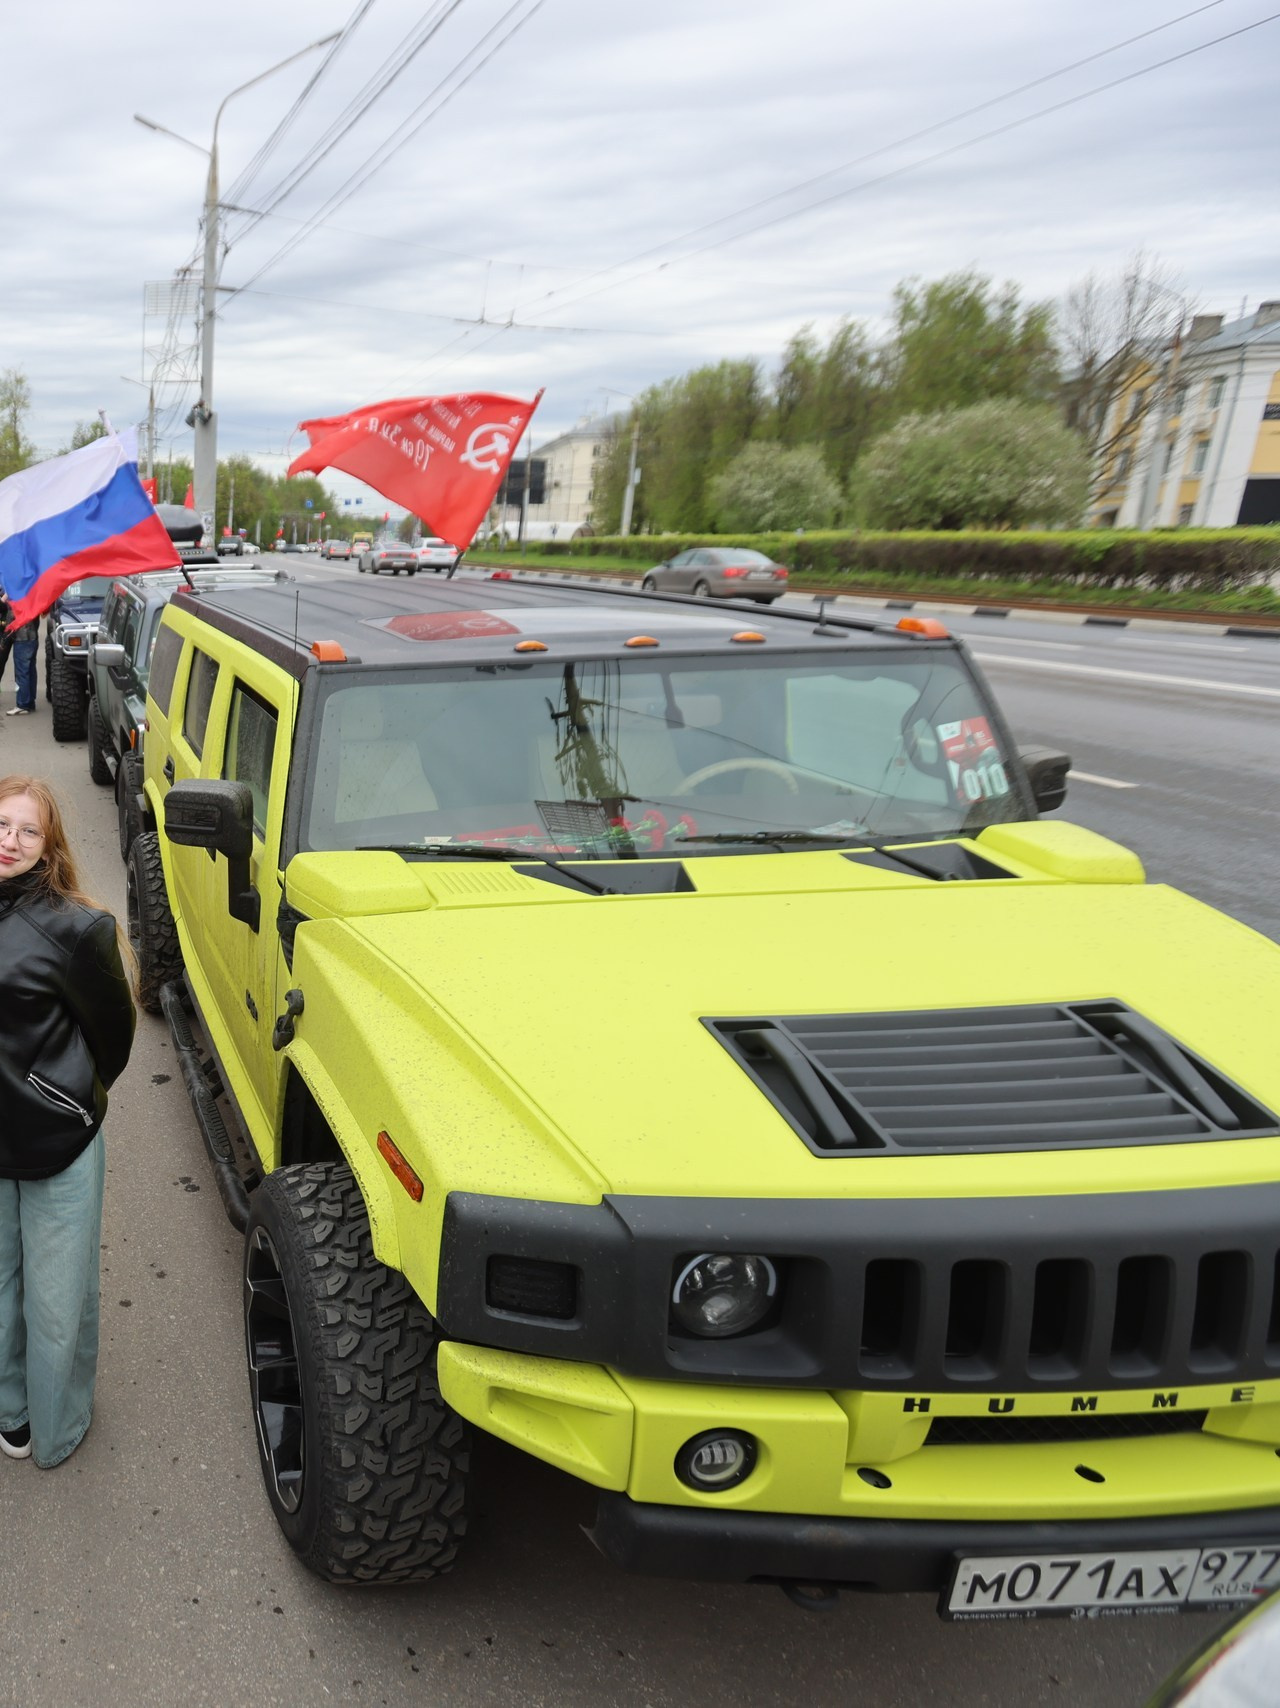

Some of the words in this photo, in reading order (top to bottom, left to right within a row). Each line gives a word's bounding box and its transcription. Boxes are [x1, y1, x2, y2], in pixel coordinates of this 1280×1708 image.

[963, 763, 1009, 800] 010
[966, 1558, 1188, 1604] М071АХ
[1202, 1549, 1280, 1583] 977
[1212, 1583, 1251, 1597] RUS
